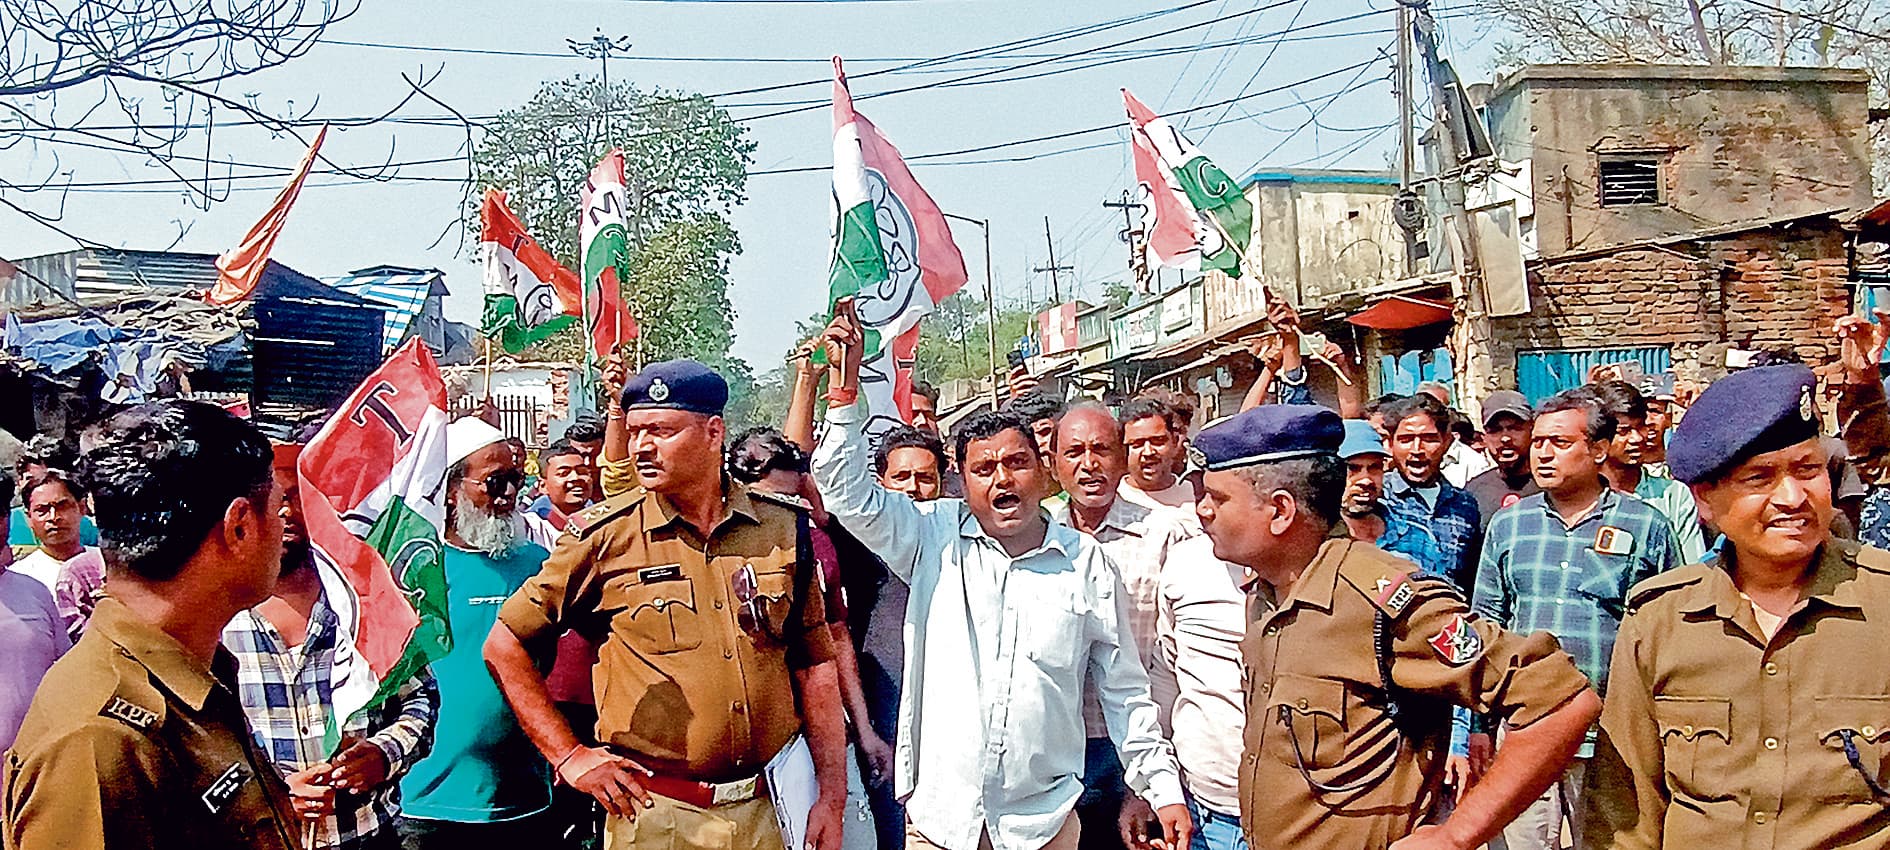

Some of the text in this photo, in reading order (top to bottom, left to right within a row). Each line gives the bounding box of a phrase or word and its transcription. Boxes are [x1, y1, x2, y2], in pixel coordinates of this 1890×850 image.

[1198, 160, 1229, 198] C
[350, 380, 414, 449] T
[388, 537, 439, 599] C
